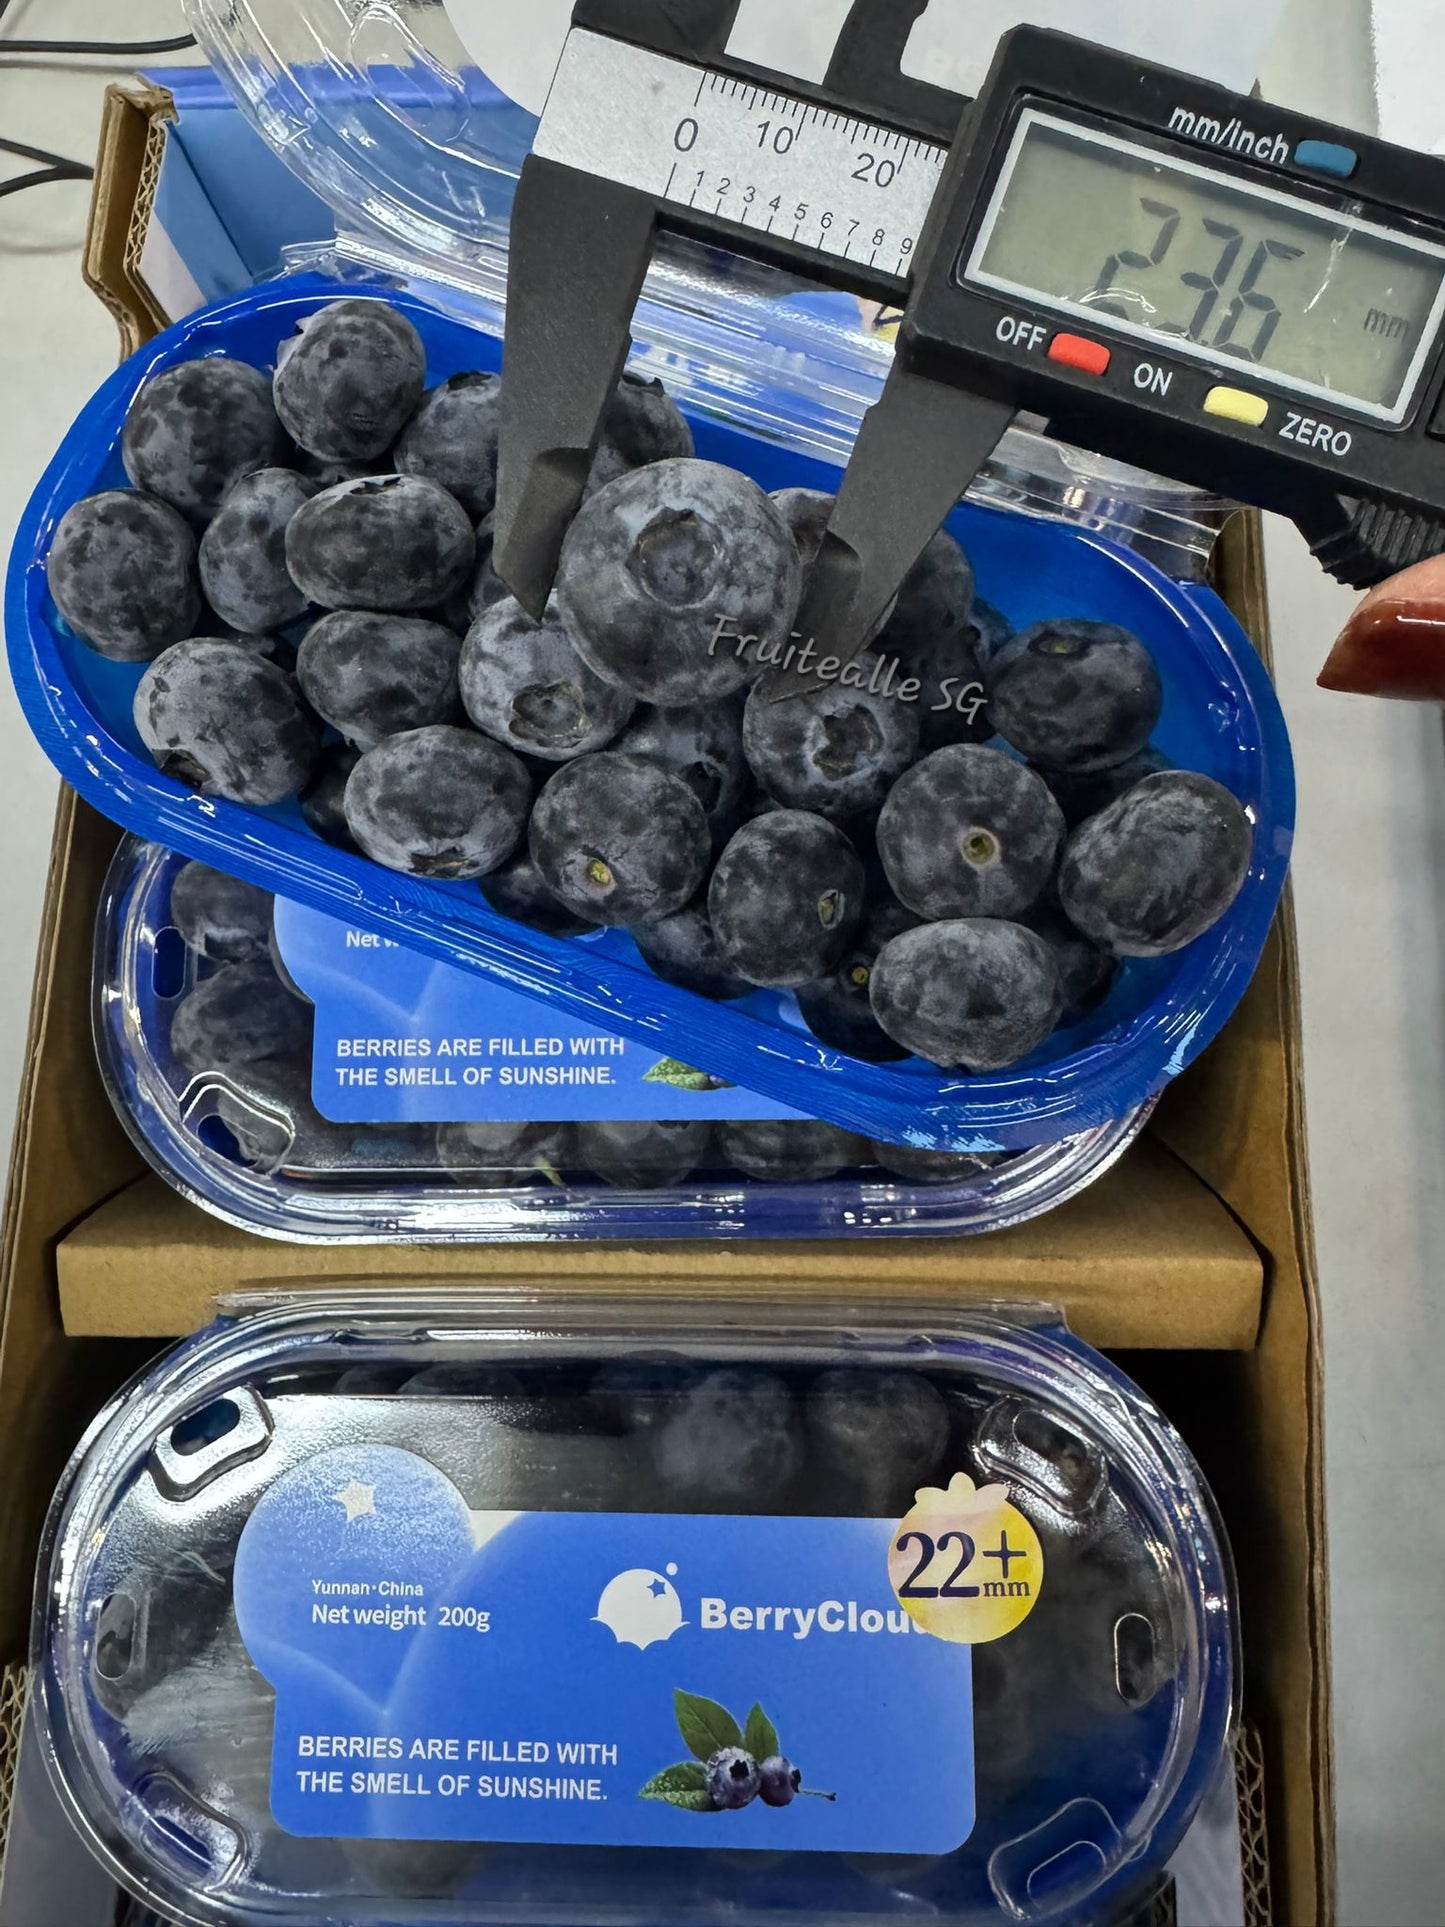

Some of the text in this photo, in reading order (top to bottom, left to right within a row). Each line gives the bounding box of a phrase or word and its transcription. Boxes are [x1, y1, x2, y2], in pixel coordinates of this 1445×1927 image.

[1167, 106, 1290, 164] mm/inch
[673, 117, 896, 188] 0 10 20
[696, 170, 913, 255] 1 2 3 4 5 6 7 8 9
[995, 315, 1047, 351] OFF
[1134, 363, 1173, 396] ON
[1279, 411, 1352, 457] ZERO
[346, 930, 381, 948] Net
[336, 1037, 625, 1057] BERRIES ARE FILLED WITH
[335, 1066, 617, 1086] THE SMELL OF SUNSHINE.
[983, 1580, 1031, 1598] mm
[312, 1604, 491, 1633] Net weight 200g
[701, 1597, 930, 1640] BerryClou
[298, 1735, 618, 1766] BERRIES ARE FILLED WITH
[297, 1770, 608, 1801] THE SMELL OF SUNSHINE.
